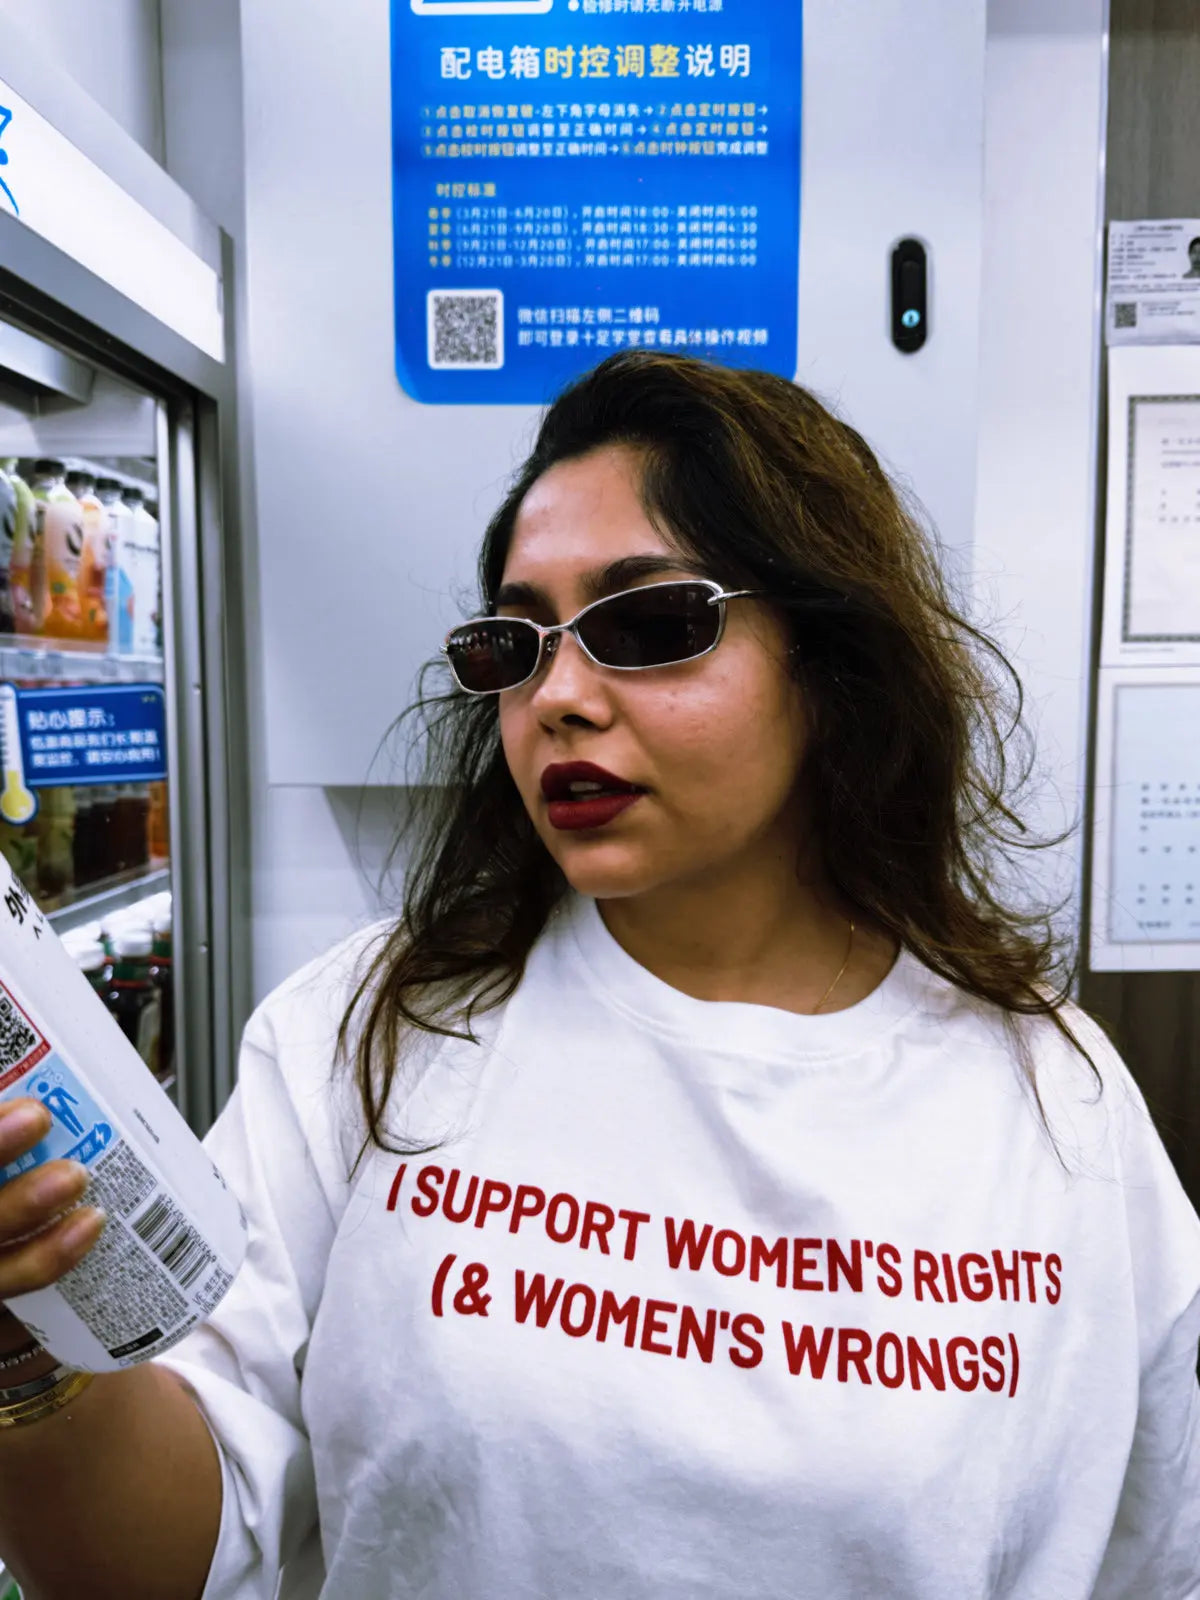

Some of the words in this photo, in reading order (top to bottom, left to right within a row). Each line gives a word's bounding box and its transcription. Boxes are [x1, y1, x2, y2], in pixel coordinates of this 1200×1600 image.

[440, 43, 751, 80] 配电箱时控调整说明
[436, 182, 496, 198] 时控标准
[518, 307, 660, 324] 微信扫描左侧二维码
[387, 1164, 406, 1211] I
[411, 1165, 650, 1260] SUPPORT
[664, 1217, 902, 1297] WOMEN'S
[914, 1249, 1062, 1304] RIGHTS
[432, 1254, 491, 1317] (&
[515, 1270, 764, 1368] WOMEN'S
[782, 1321, 1019, 1397] WRONGS)
